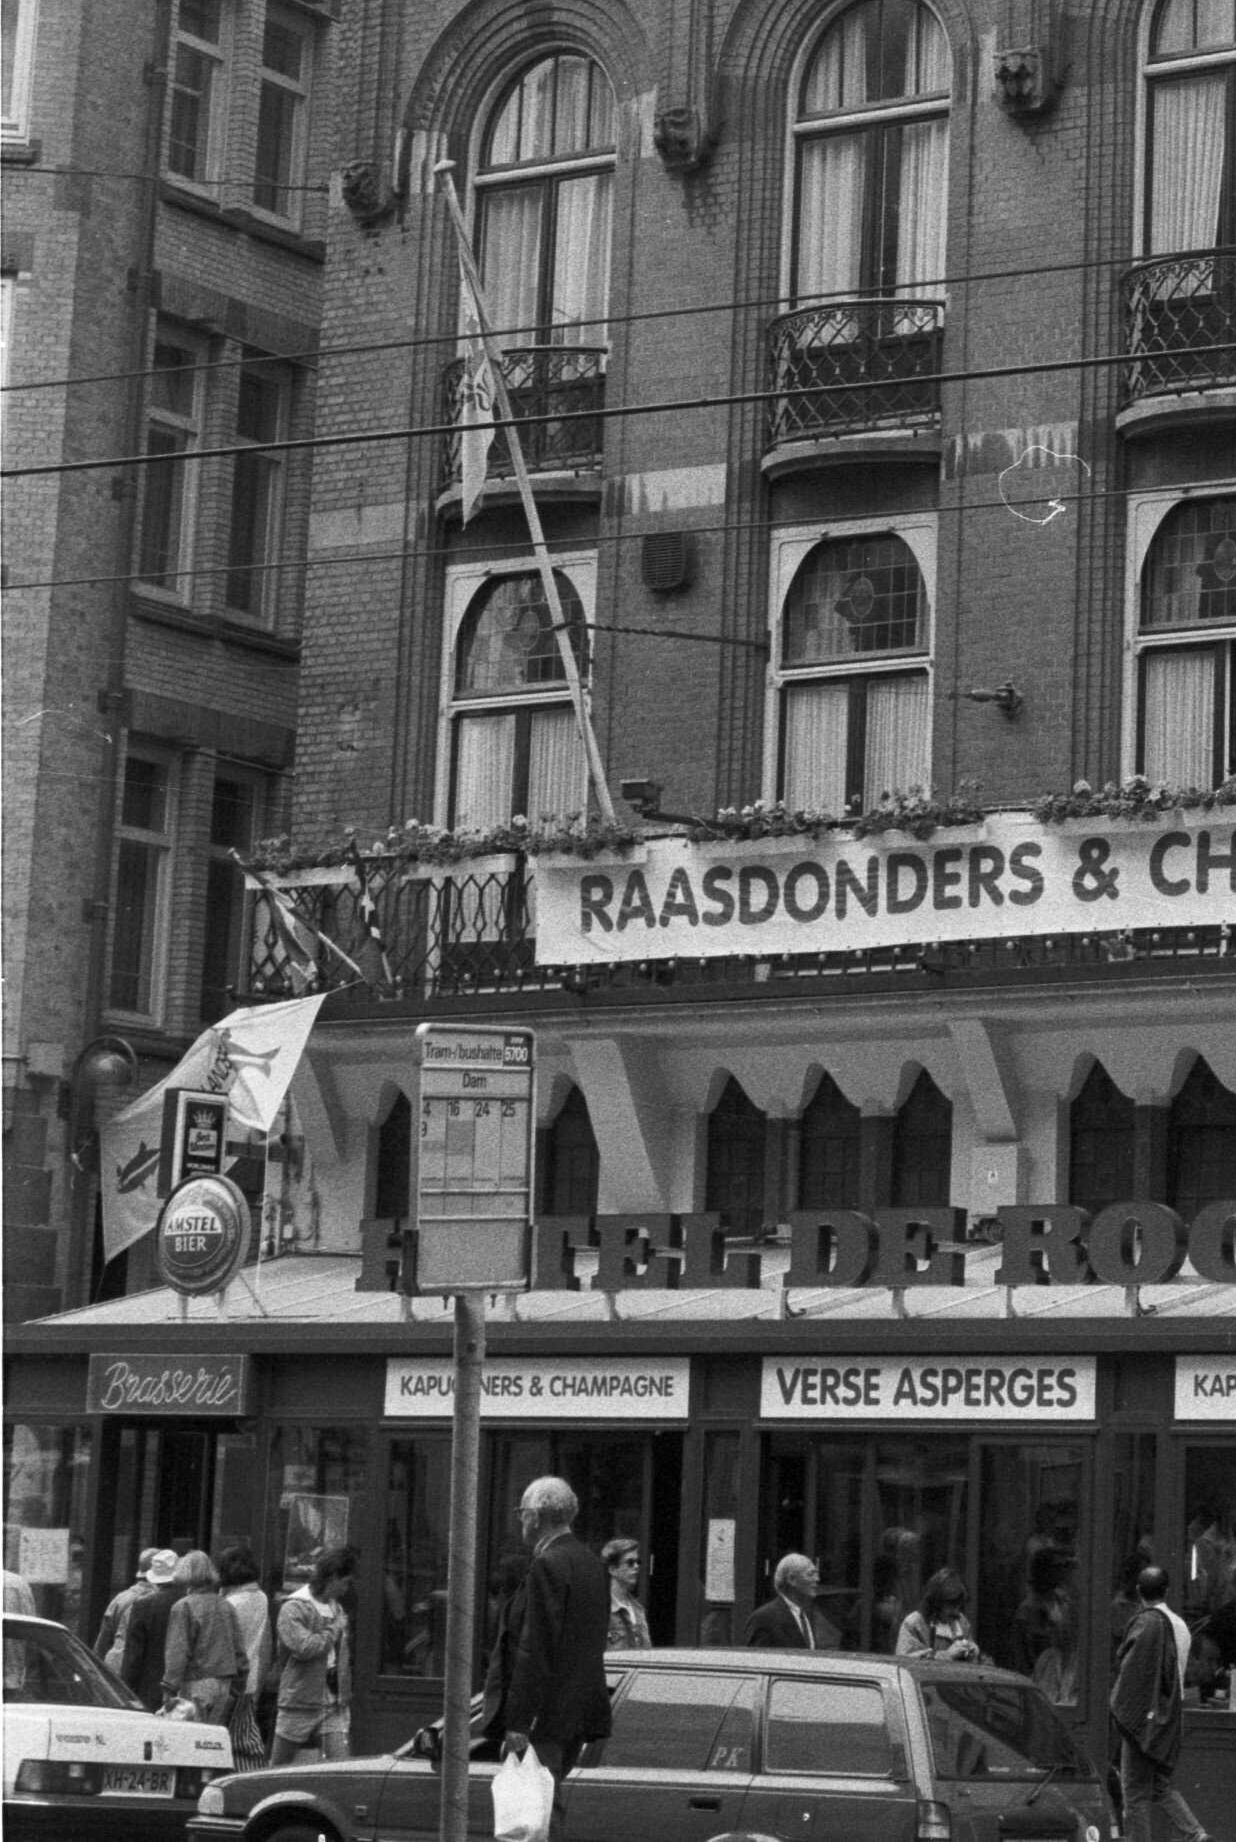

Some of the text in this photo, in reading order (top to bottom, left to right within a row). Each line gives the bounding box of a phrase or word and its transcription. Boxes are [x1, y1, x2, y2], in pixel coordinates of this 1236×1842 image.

[580, 841, 1044, 934] RAASDONDERS
[1072, 836, 1119, 903] &
[424, 1041, 503, 1061] Tram-/bushalte
[462, 1072, 487, 1089] Dam
[475, 1101, 490, 1118] 24
[502, 1101, 516, 1118] 25
[166, 1216, 218, 1233] AMSTEL
[174, 1235, 208, 1252] BIER
[784, 1206, 968, 1288] DE
[101, 1361, 238, 1409] Brasserie
[400, 1375, 674, 1397] KAPUNERS & CHAMPAGNE
[776, 1366, 1078, 1408] VERSE ASPERGES
